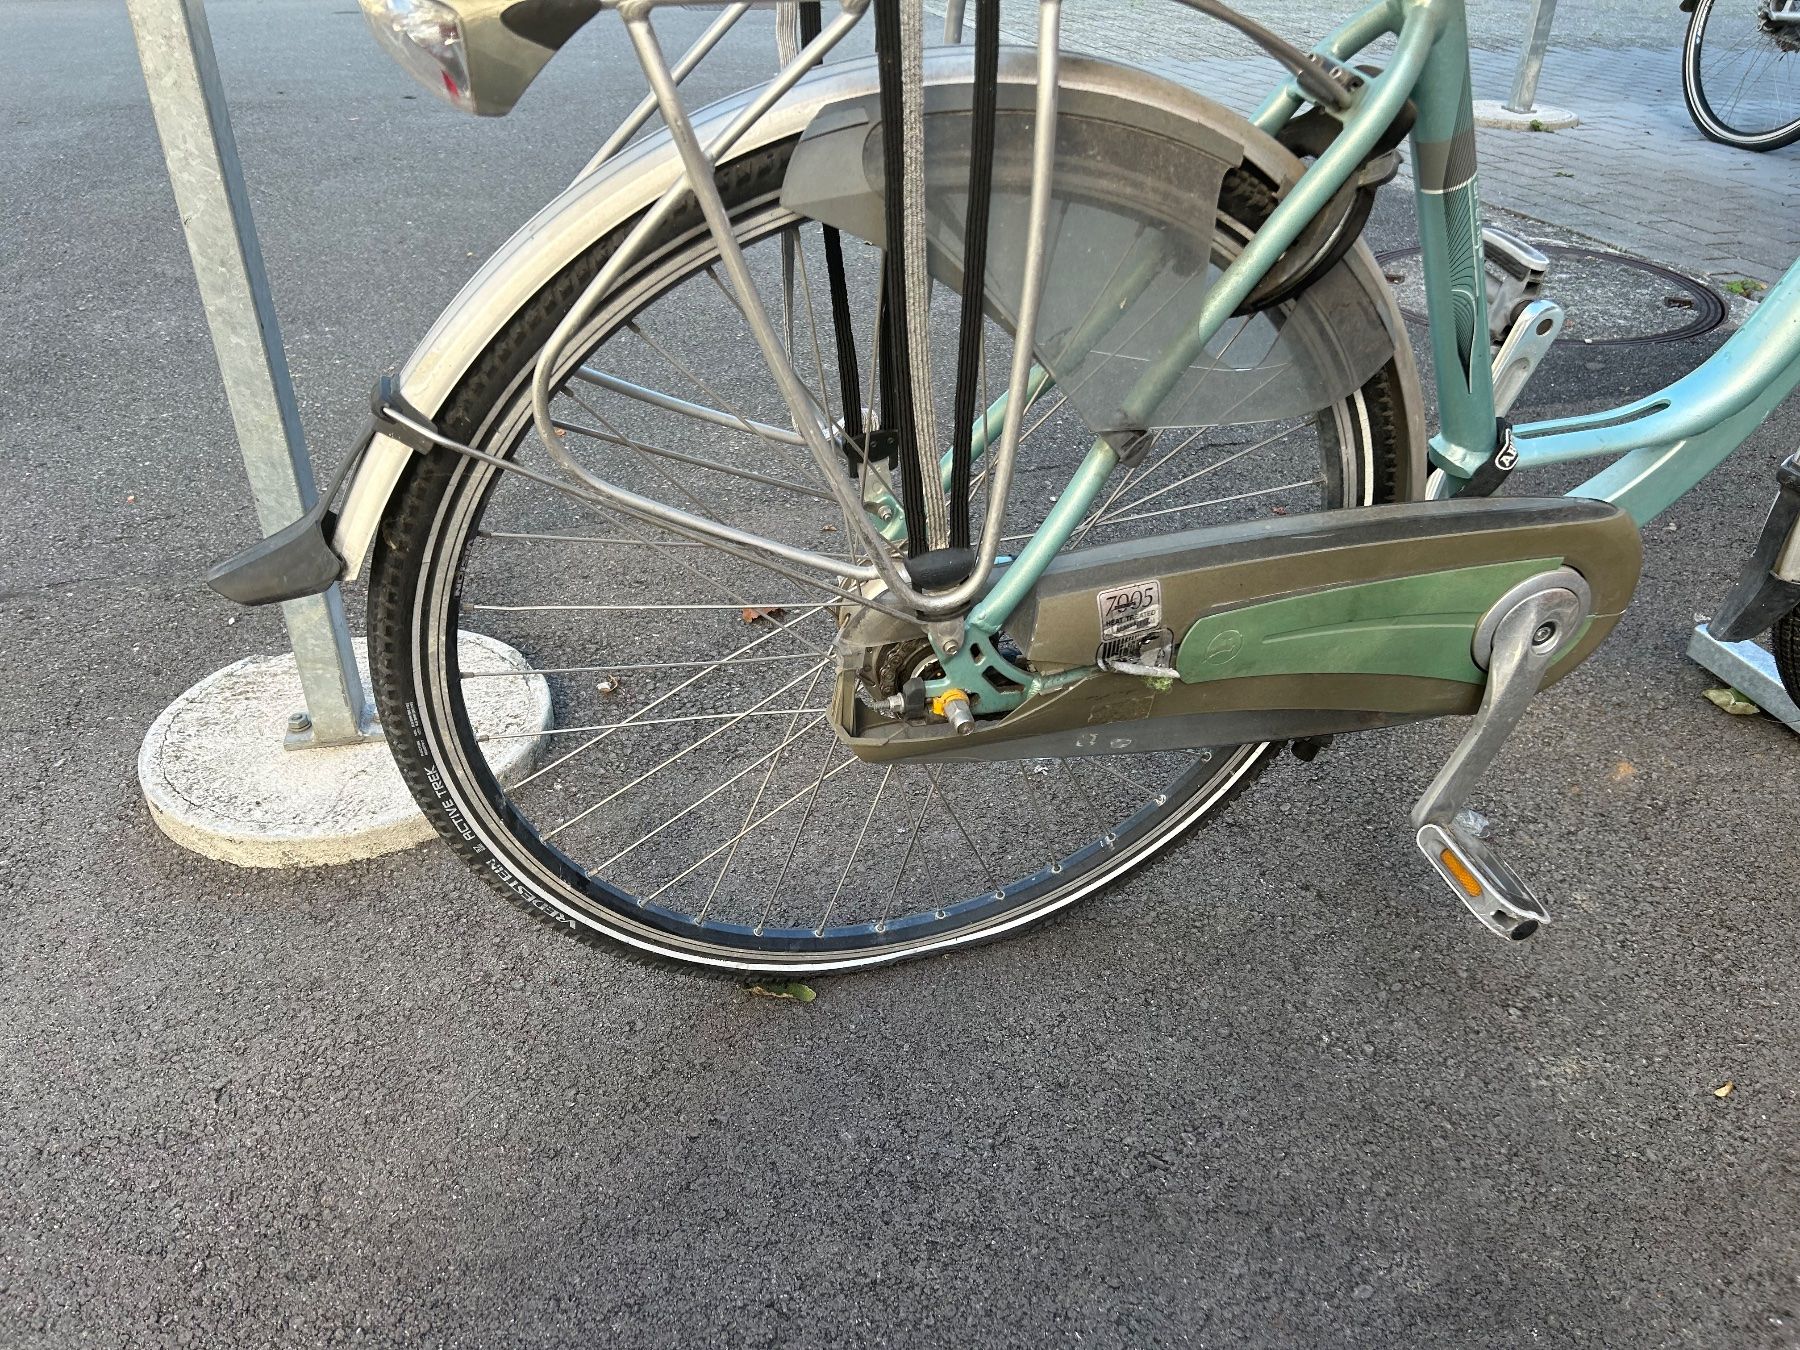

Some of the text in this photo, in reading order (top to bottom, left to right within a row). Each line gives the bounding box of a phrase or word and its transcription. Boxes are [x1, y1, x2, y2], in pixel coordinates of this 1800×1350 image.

[1105, 586, 1154, 617] 7005
[1105, 616, 1126, 628] HEAT
[1127, 609, 1156, 622] TREATED
[423, 764, 449, 799] TREK
[441, 799, 476, 842] ACTIVE
[485, 857, 577, 930] VREDESTEIN
